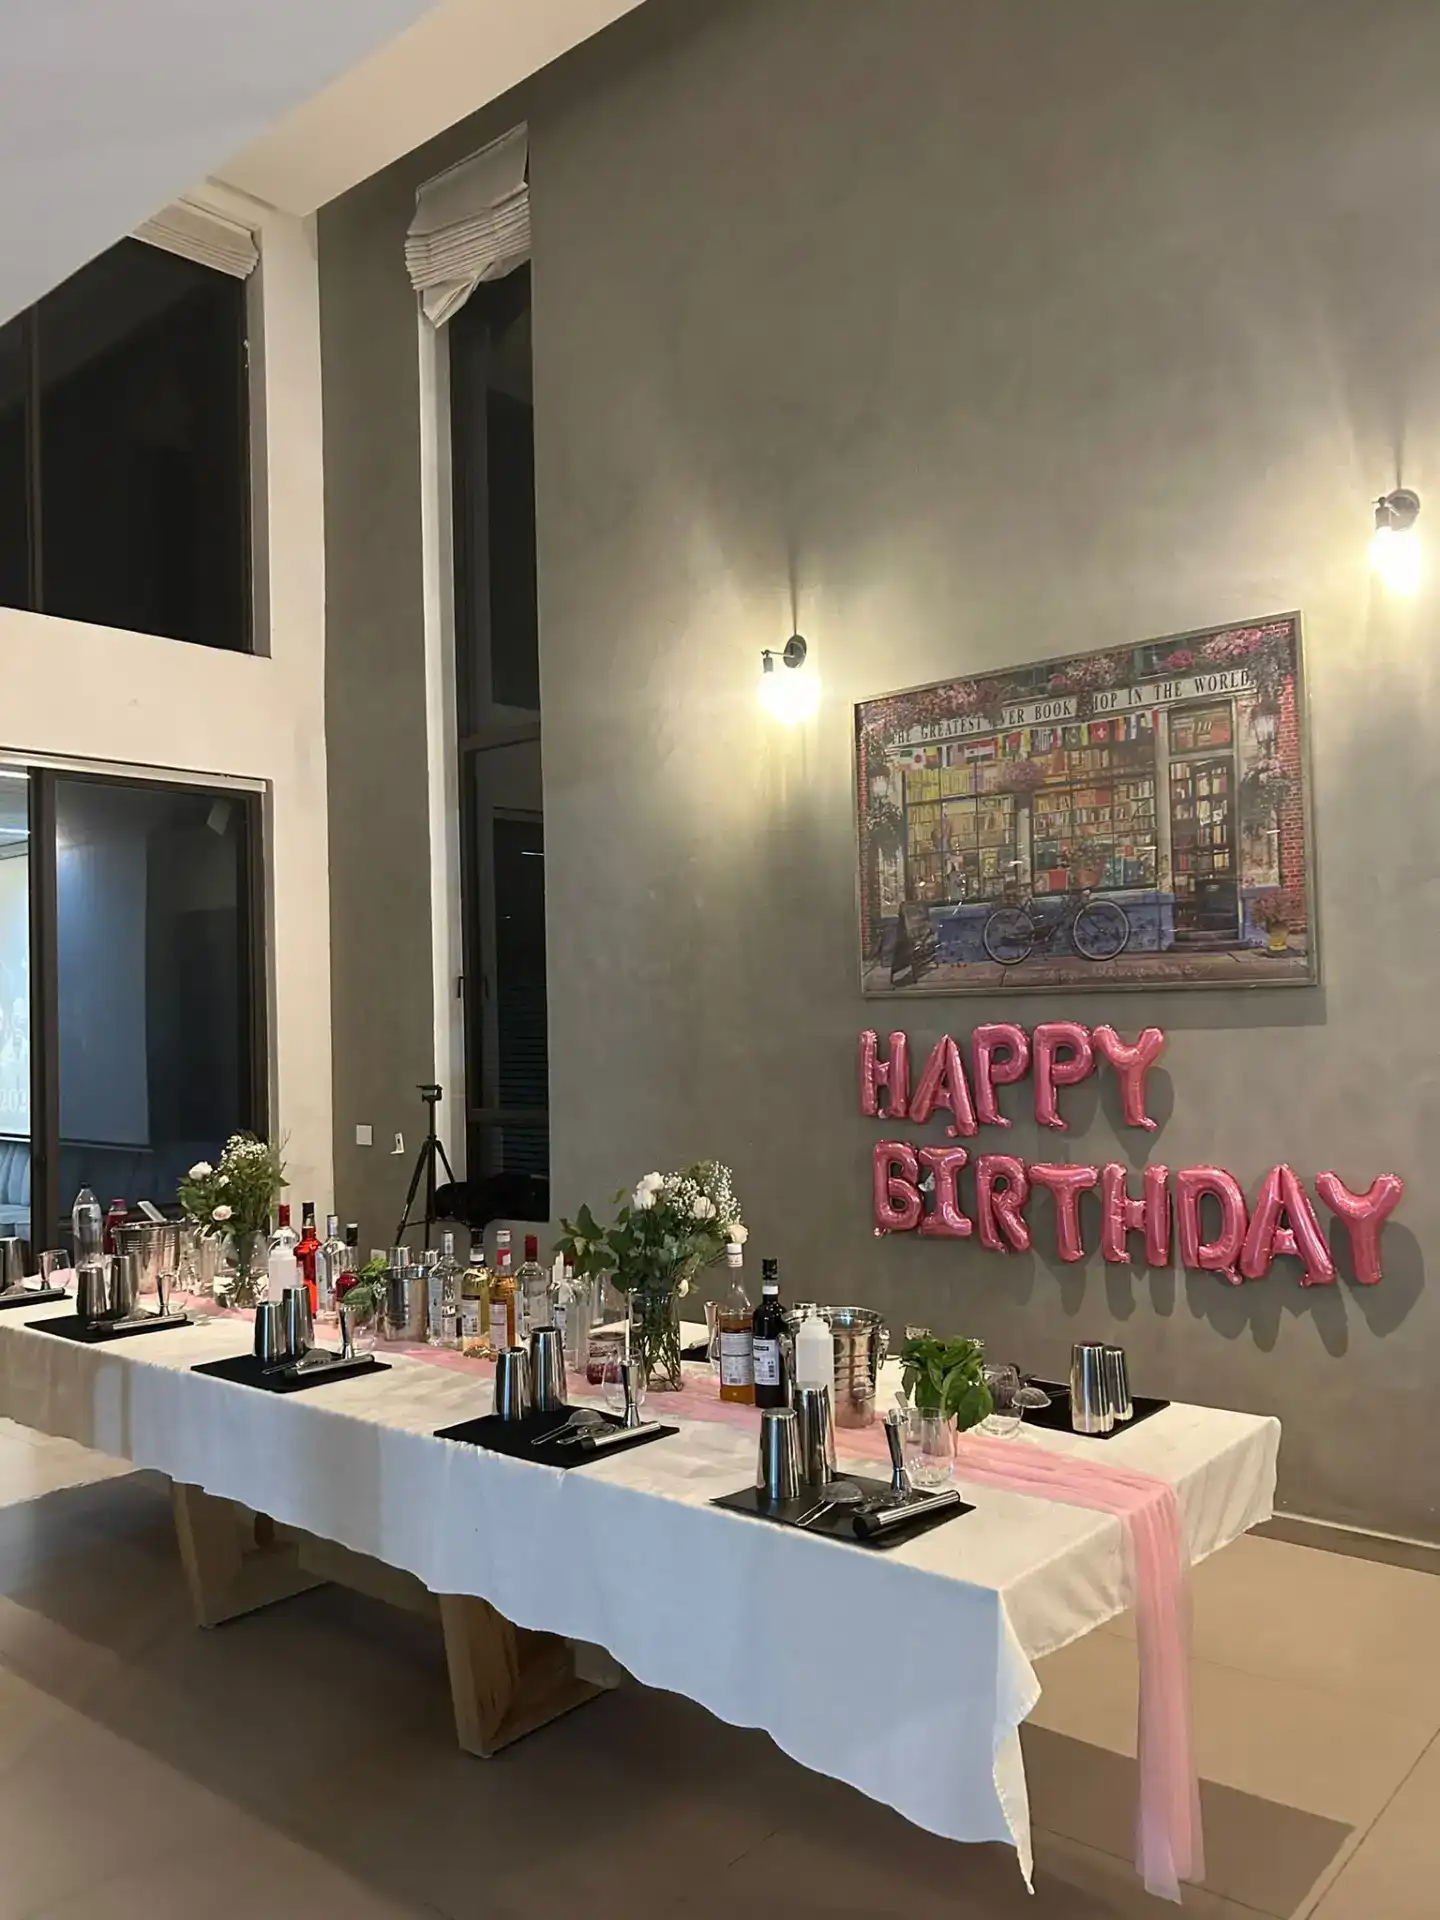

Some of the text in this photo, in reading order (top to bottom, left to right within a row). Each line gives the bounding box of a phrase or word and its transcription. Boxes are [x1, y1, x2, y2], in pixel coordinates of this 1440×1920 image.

[920, 716, 983, 740] GREATEST
[1034, 700, 1072, 721] BOOK
[1127, 687, 1143, 705] IN
[1154, 681, 1183, 701] THE
[859, 1021, 1165, 1138] HAPPY
[872, 1139, 1403, 1288] BIRTHDAY
